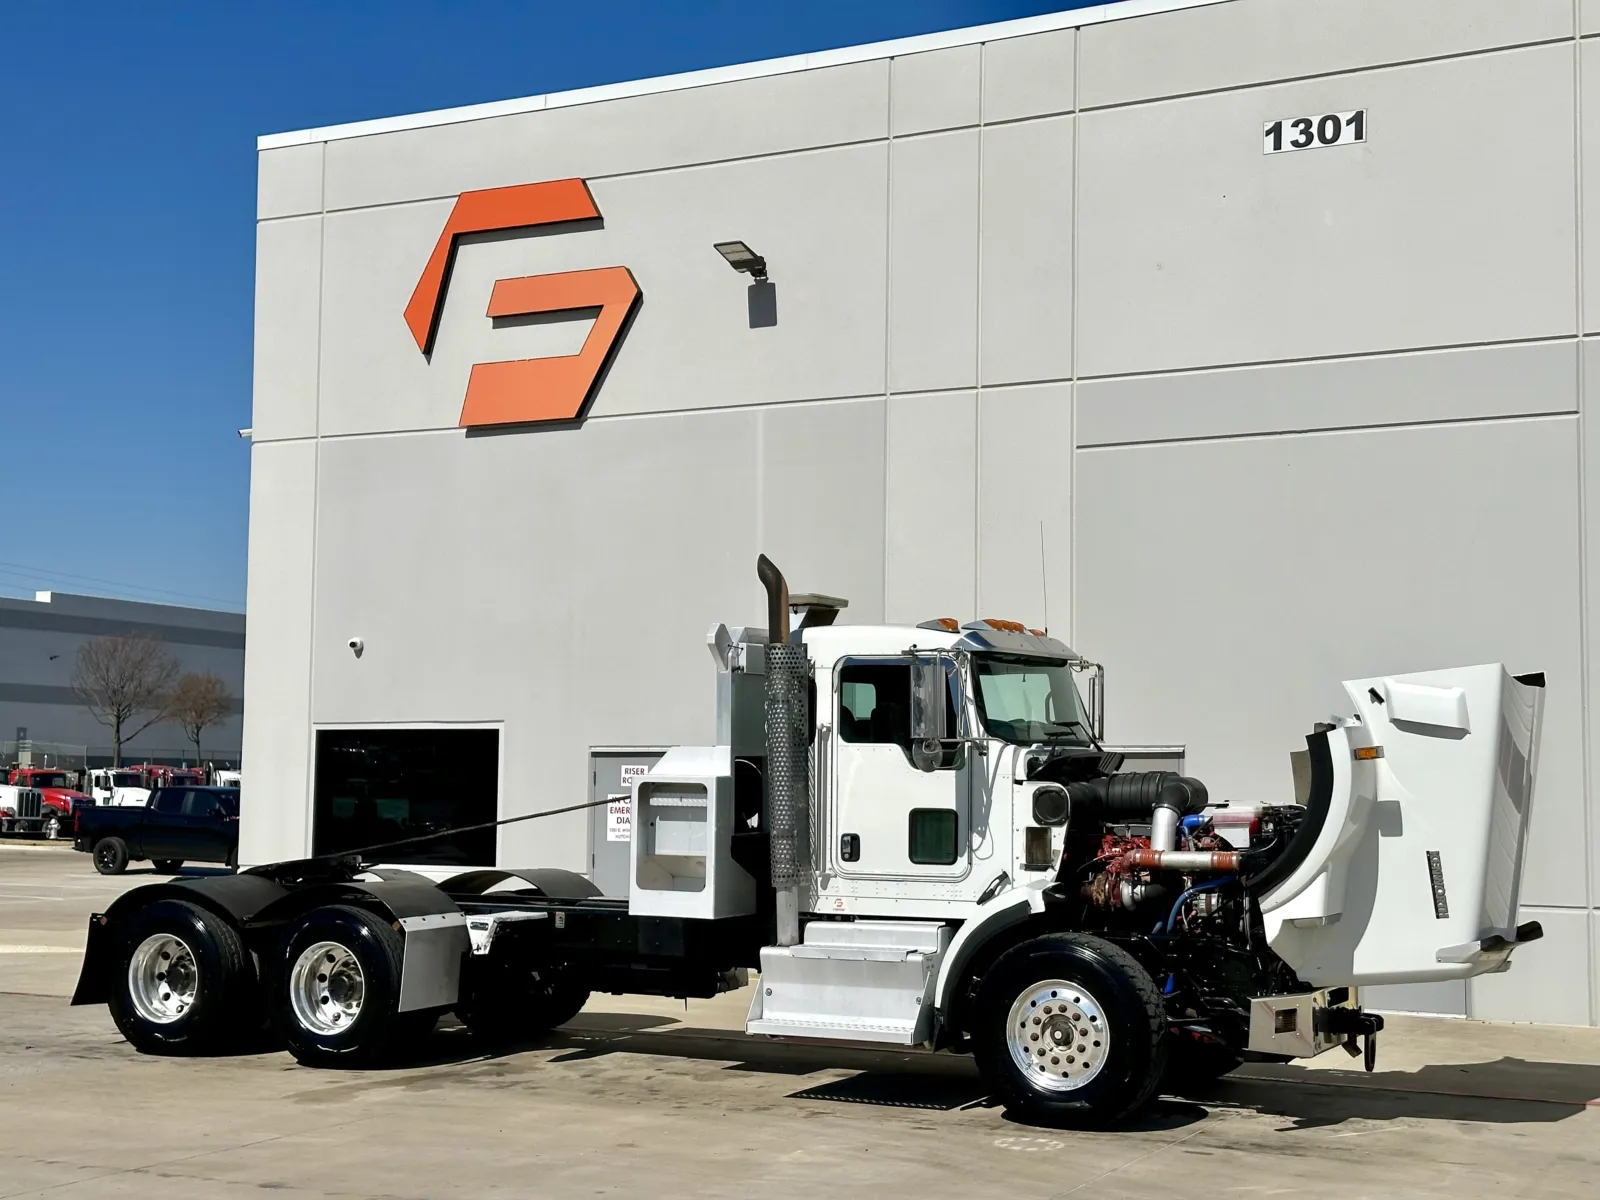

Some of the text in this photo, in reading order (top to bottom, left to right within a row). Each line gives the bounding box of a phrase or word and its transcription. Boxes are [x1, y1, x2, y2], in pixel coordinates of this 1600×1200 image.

[1265, 110, 1364, 151] 1301
[624, 767, 645, 775] RISER
[609, 806, 631, 814] EMER
[616, 816, 631, 824] DIA
[1427, 851, 1449, 919] KENWORTH
